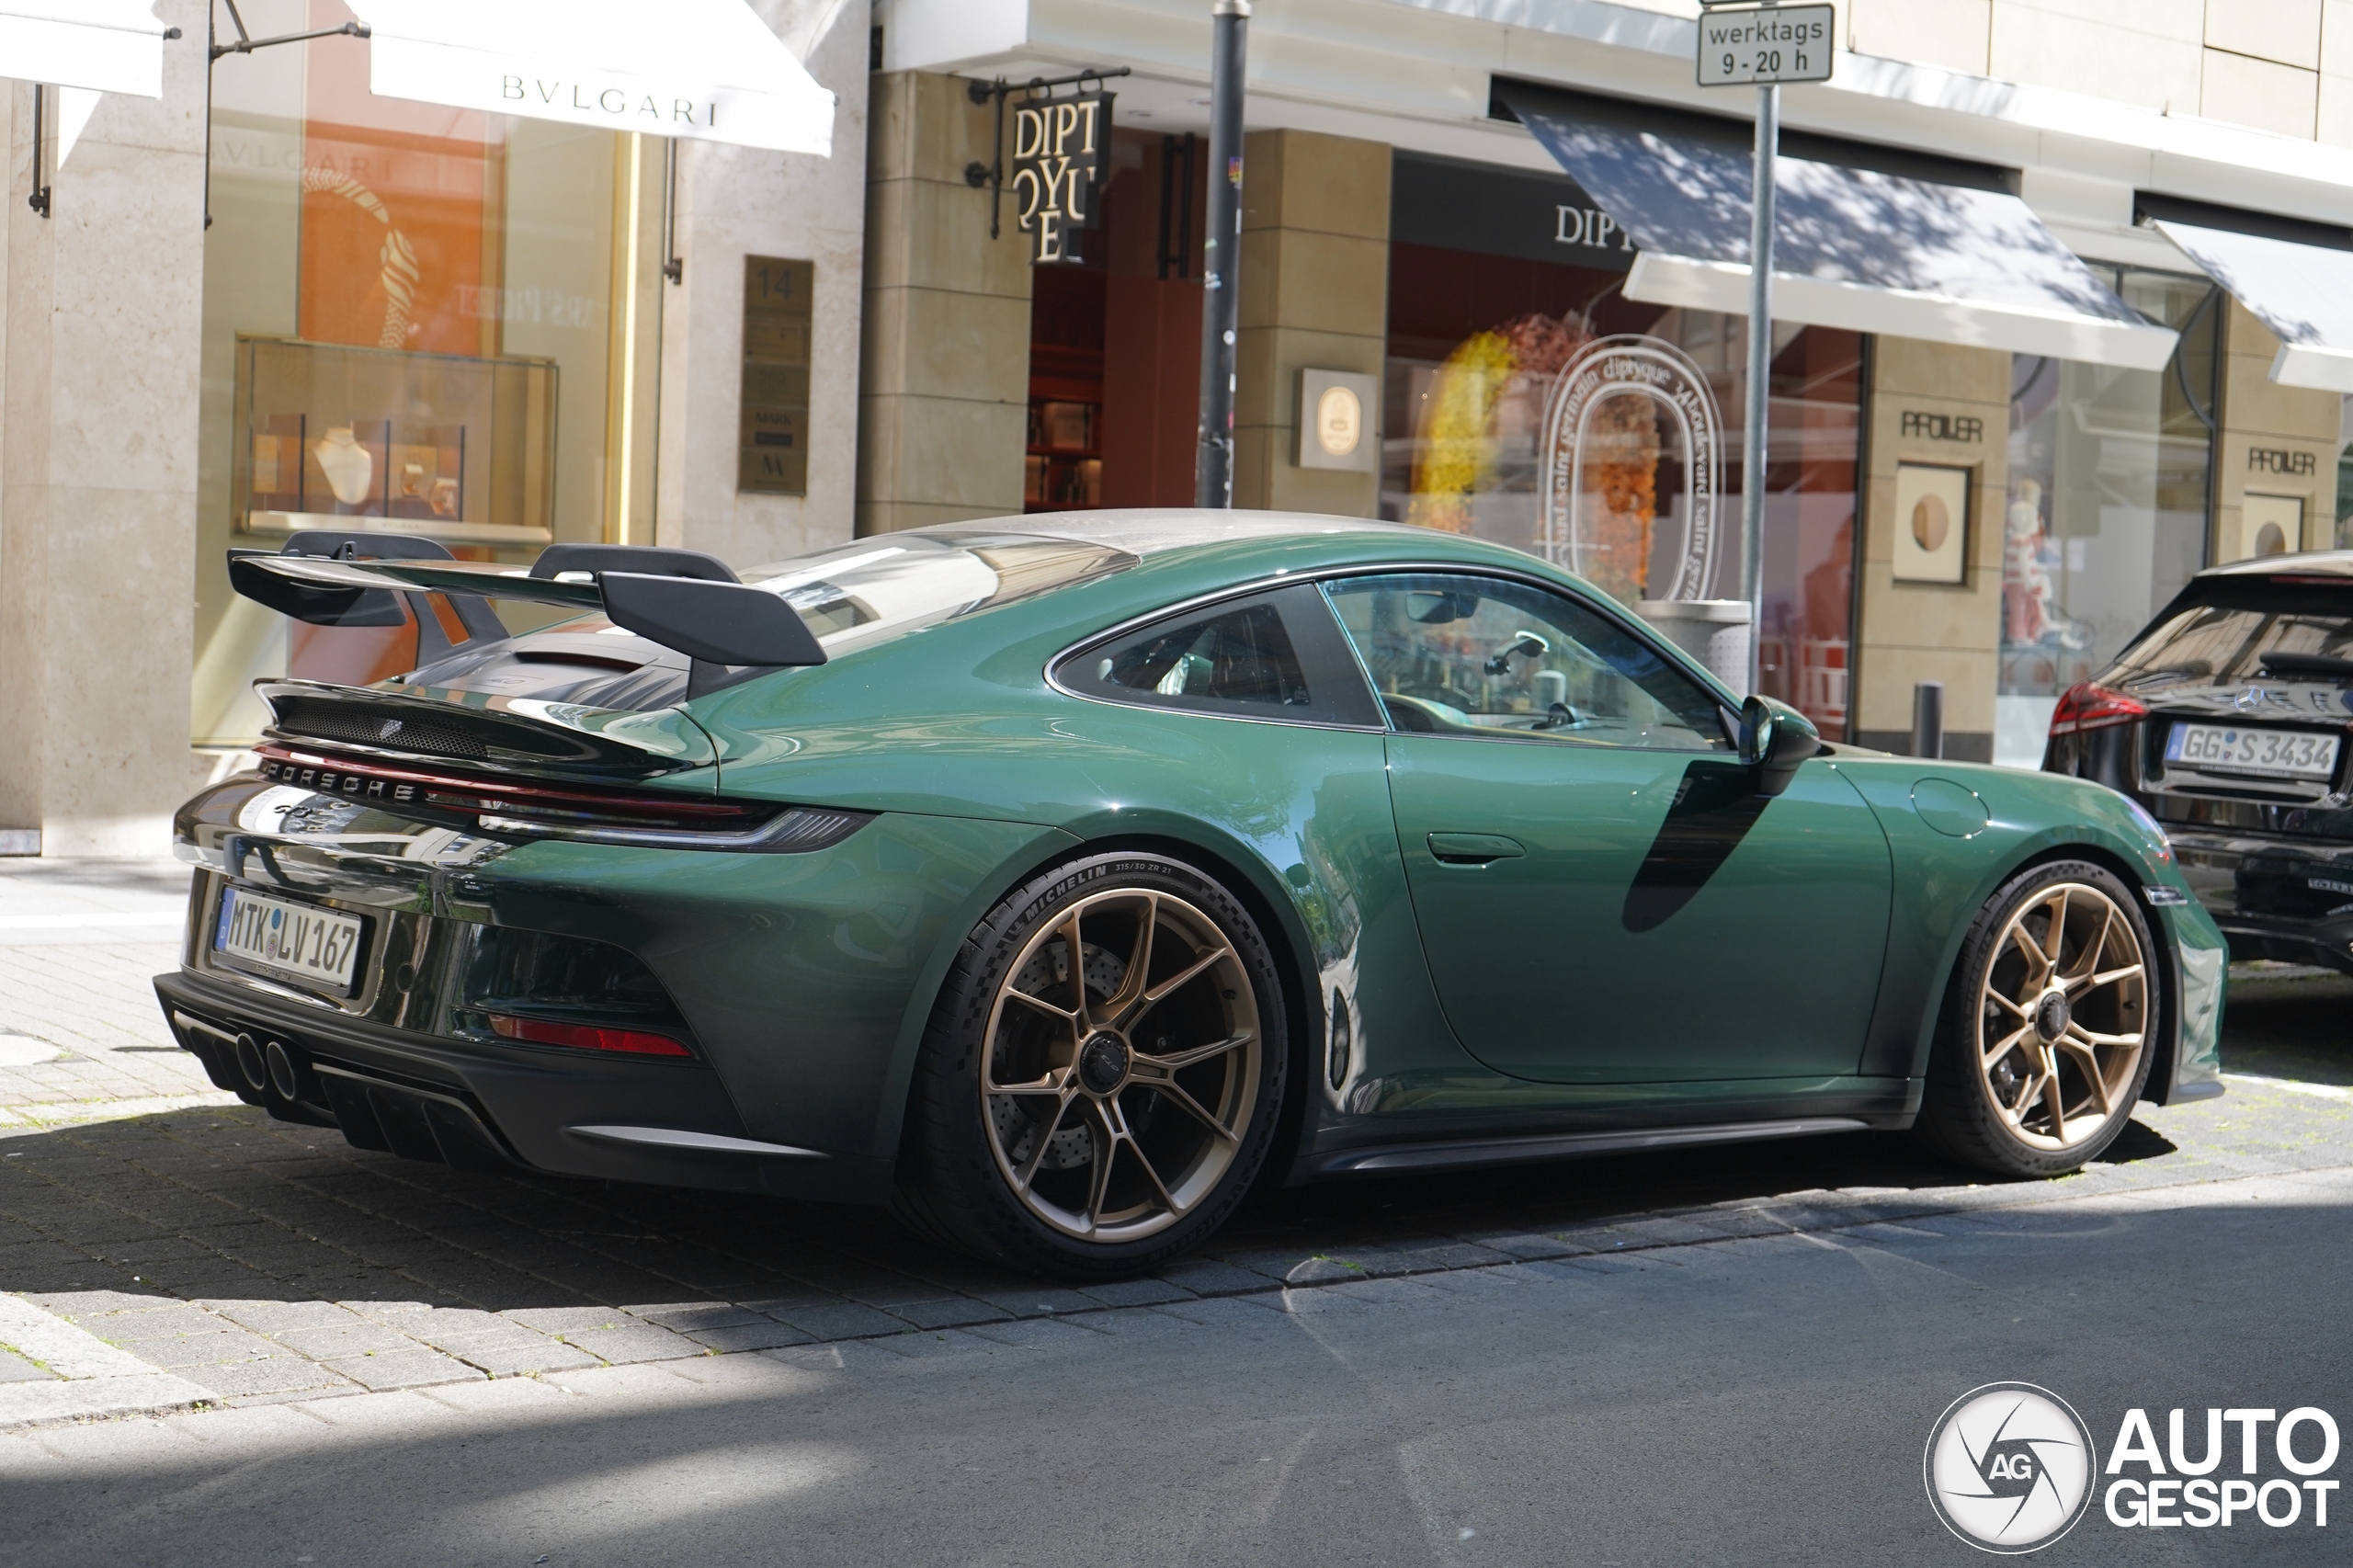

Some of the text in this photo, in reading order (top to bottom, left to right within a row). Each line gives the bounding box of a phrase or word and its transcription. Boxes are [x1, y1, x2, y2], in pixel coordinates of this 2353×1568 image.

[1709, 20, 1824, 45] werktags
[1795, 49, 1808, 71] h
[503, 75, 716, 127] BVLGARI
[1015, 102, 1099, 158] DIPT
[1036, 210, 1062, 263] E
[756, 267, 792, 300] 14
[1603, 356, 1672, 385] diptyque
[1561, 369, 1599, 449] germain
[1686, 395, 1710, 500] boulevard
[1693, 503, 1710, 556] saint
[2185, 730, 2222, 759] GG
[267, 762, 415, 801] PORSCHE
[1025, 865, 1107, 922] MICHELIN
[1115, 863, 1172, 874] 315/30 ZR 21
[228, 899, 270, 954] MTK
[308, 919, 356, 974] 167
